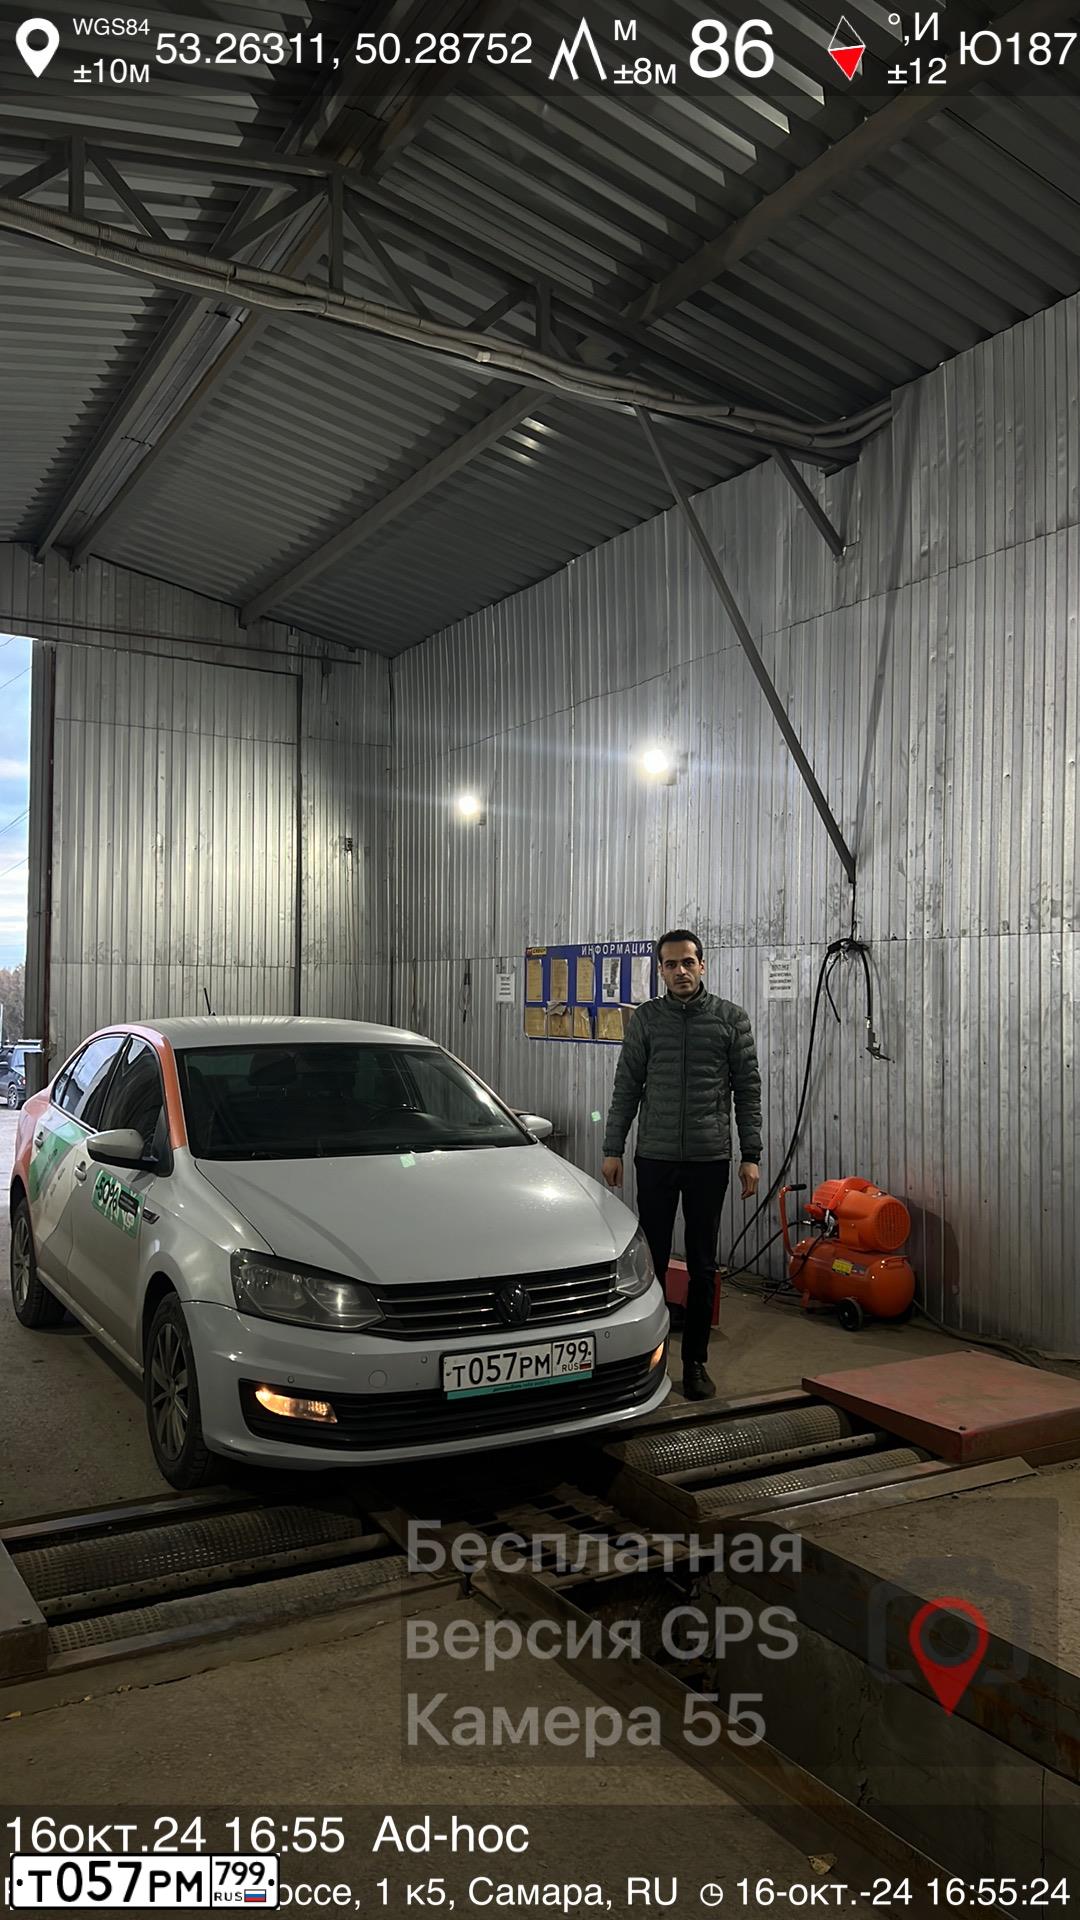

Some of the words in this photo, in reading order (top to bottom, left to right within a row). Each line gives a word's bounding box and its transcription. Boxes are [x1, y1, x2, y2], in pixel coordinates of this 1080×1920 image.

[581, 942, 653, 956] ИНФОРМАЦИЯ
[452, 1352, 550, 1387] Т057РМ
[554, 1340, 589, 1365] 799
[562, 1362, 579, 1373] RUS
